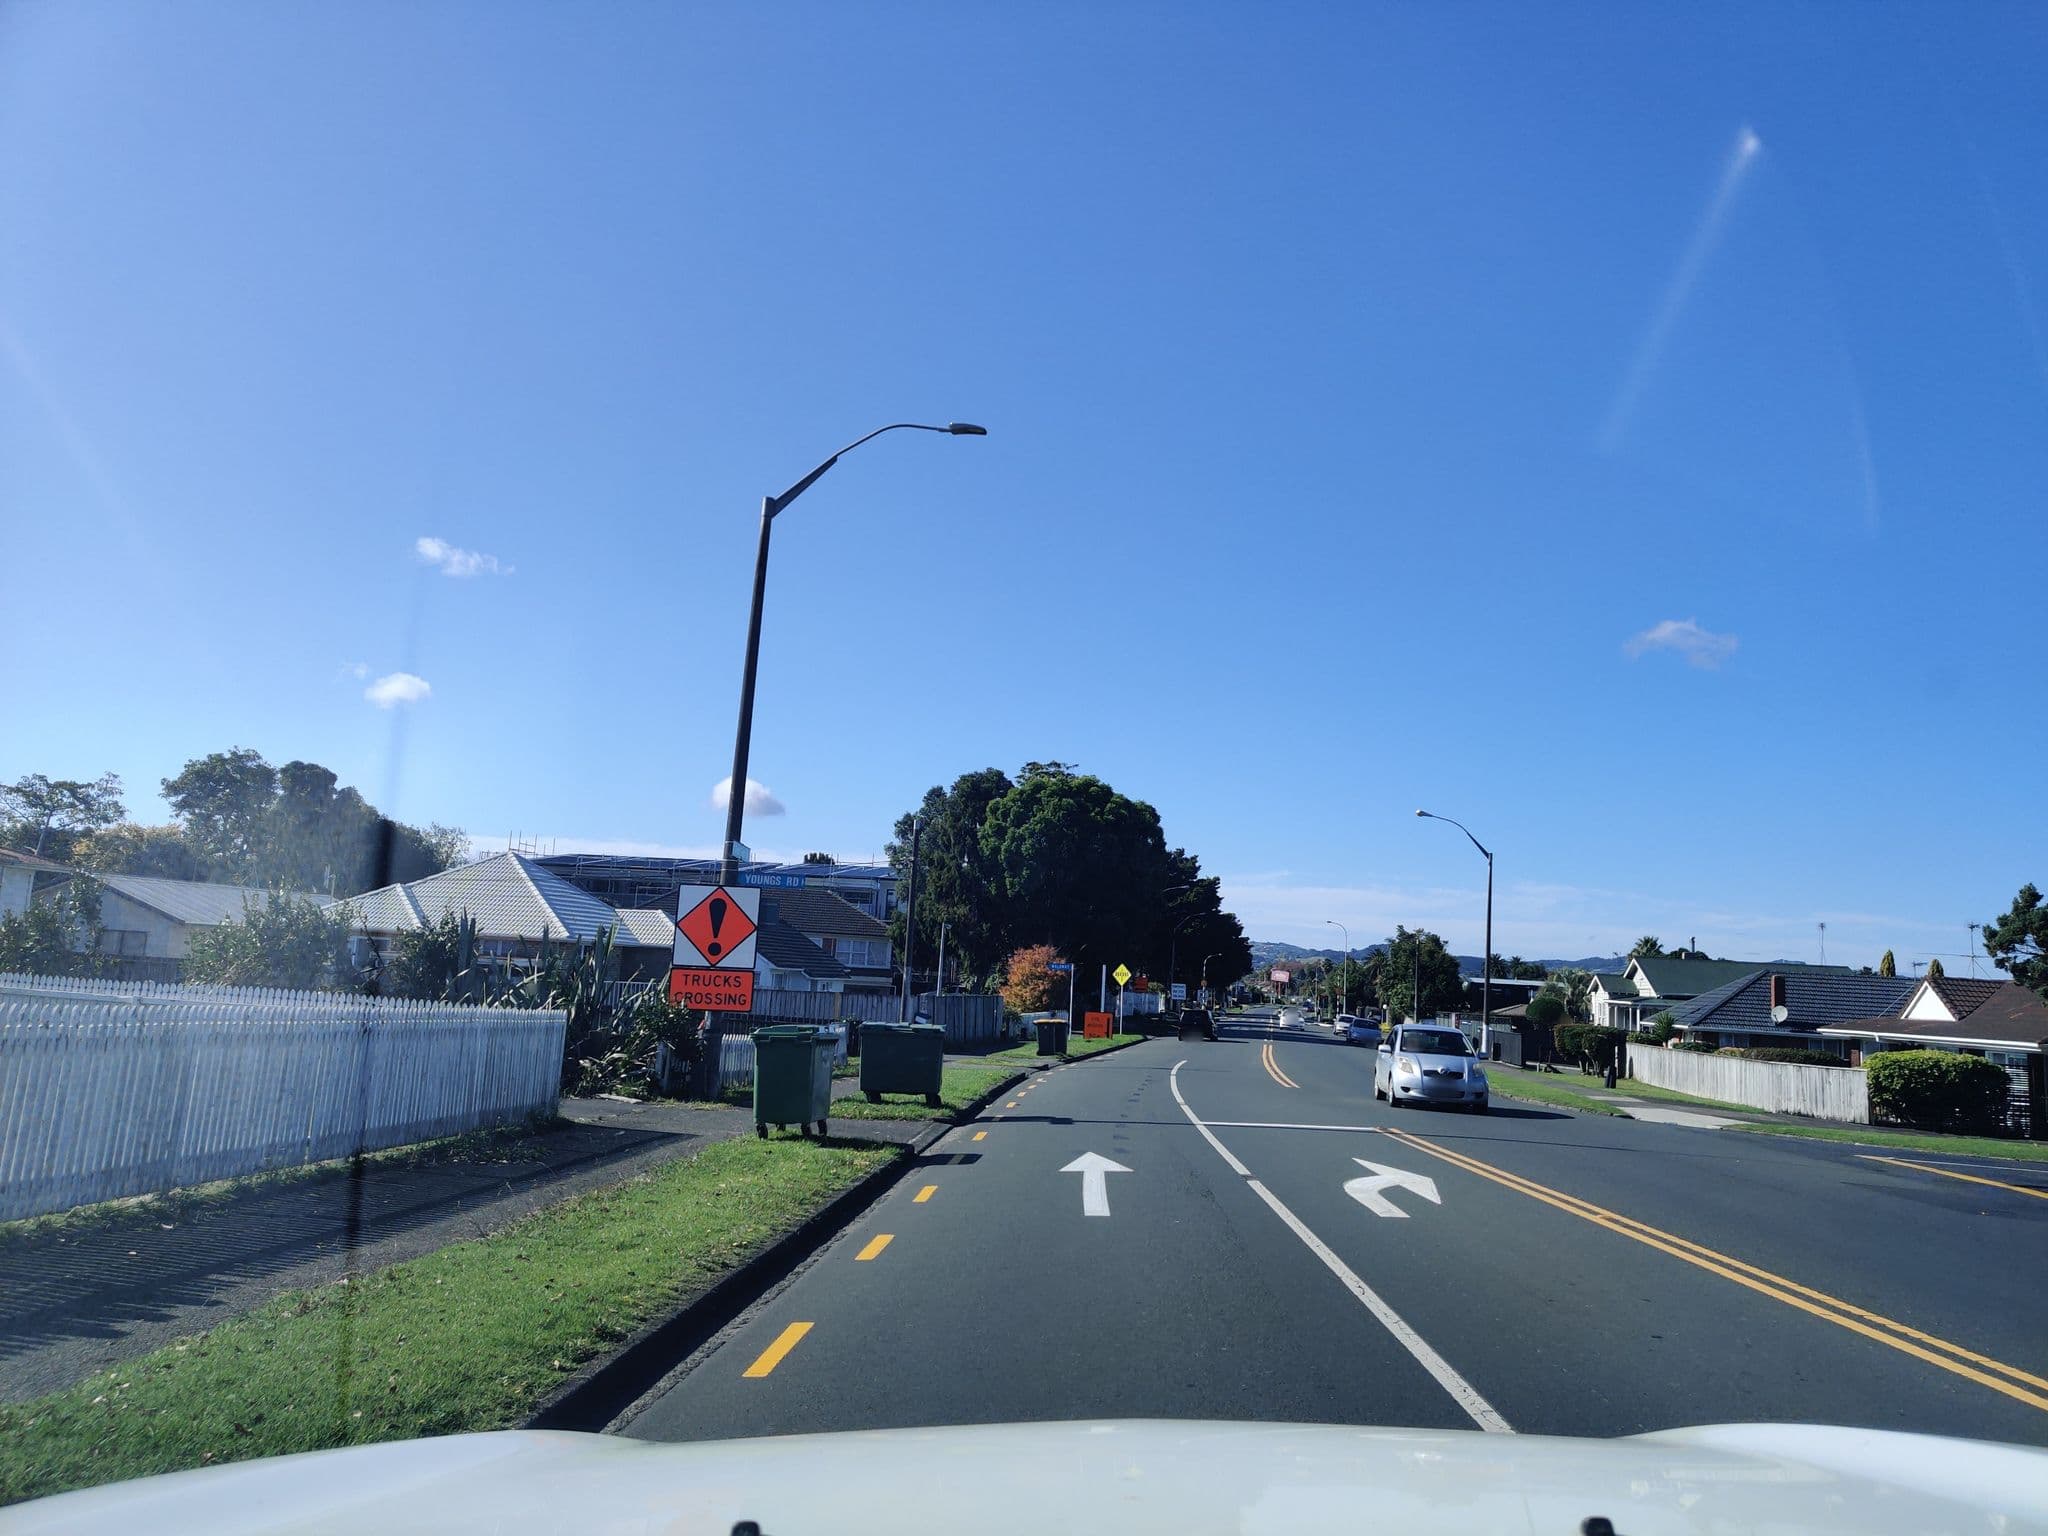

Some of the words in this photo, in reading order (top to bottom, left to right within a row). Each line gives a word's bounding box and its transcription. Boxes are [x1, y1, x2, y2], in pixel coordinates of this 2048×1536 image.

[745, 874, 781, 886] YOUNGS
[786, 876, 799, 887] RD
[683, 974, 742, 988] TRUCKS
[674, 991, 747, 1006] CROSSING
